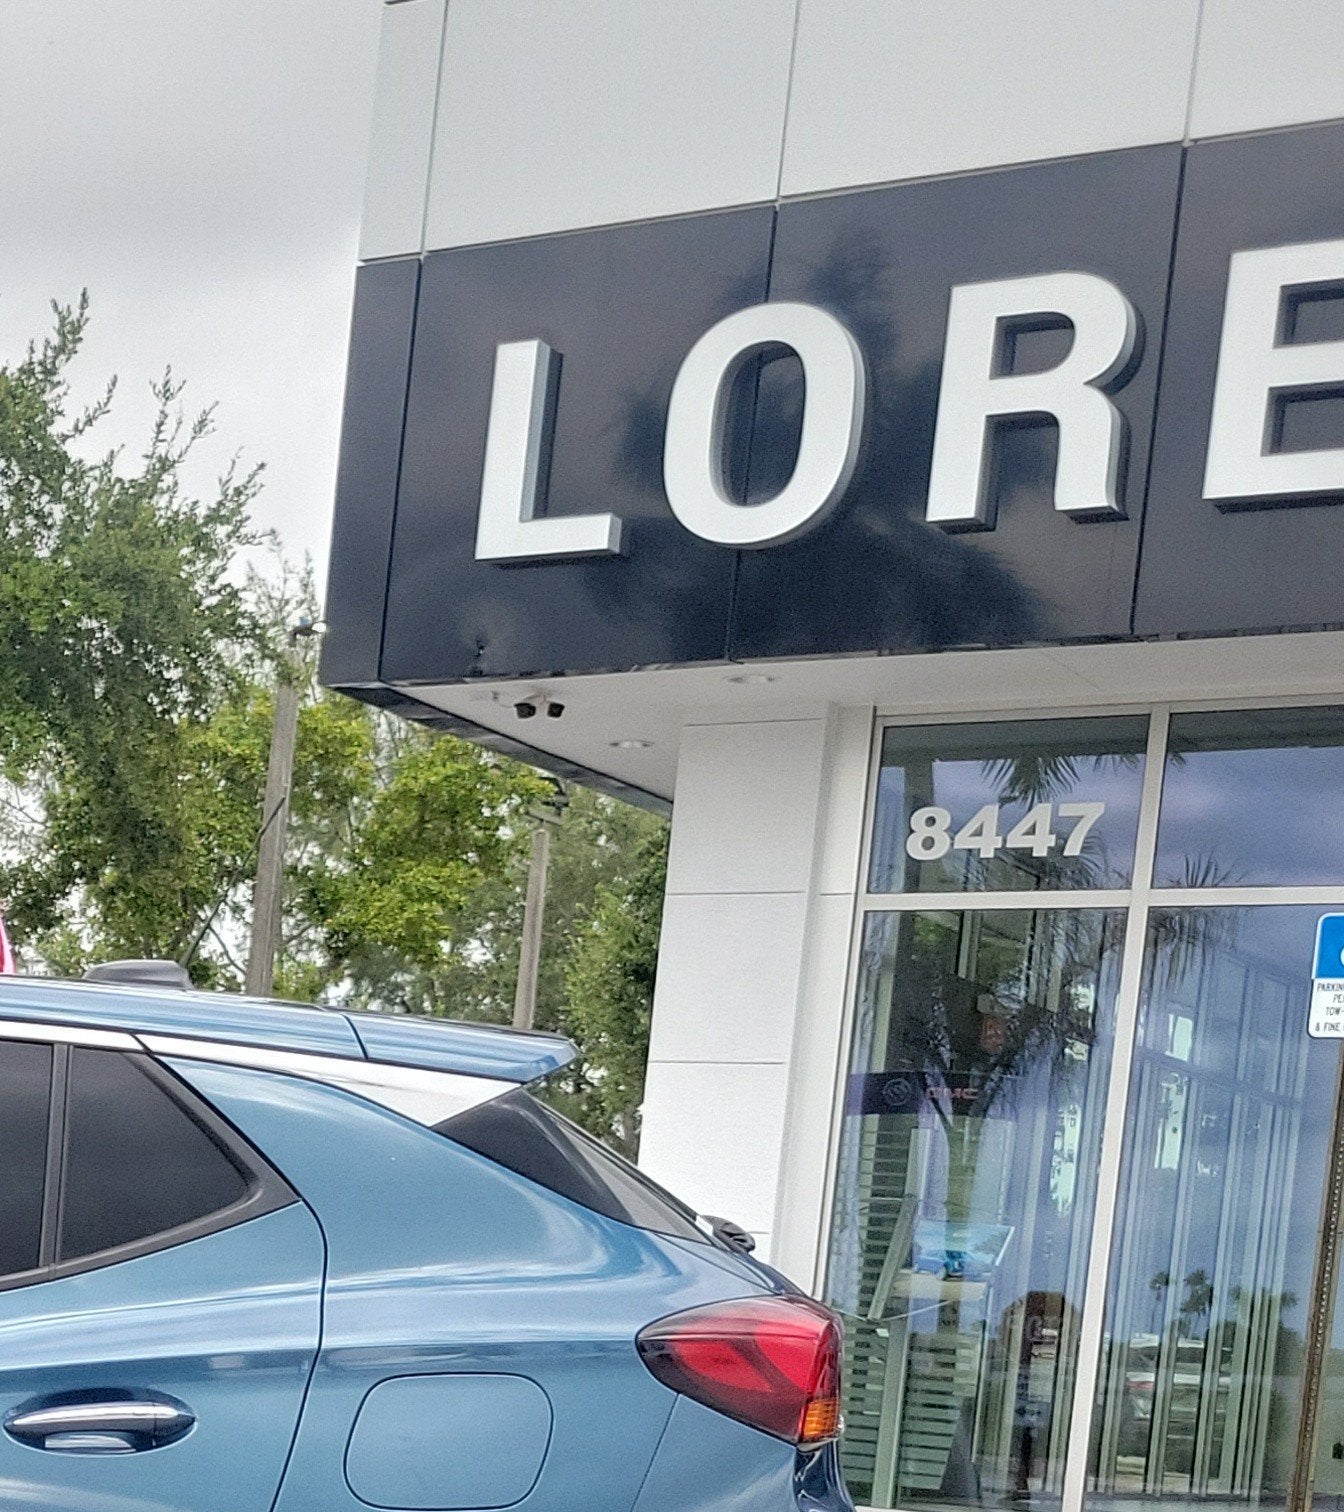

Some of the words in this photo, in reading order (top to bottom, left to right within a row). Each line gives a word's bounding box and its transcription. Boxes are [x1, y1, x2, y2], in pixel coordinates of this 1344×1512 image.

[475, 240, 1344, 564] LORE
[906, 802, 1105, 861] 8447
[1323, 1022, 1341, 1031] FINE
